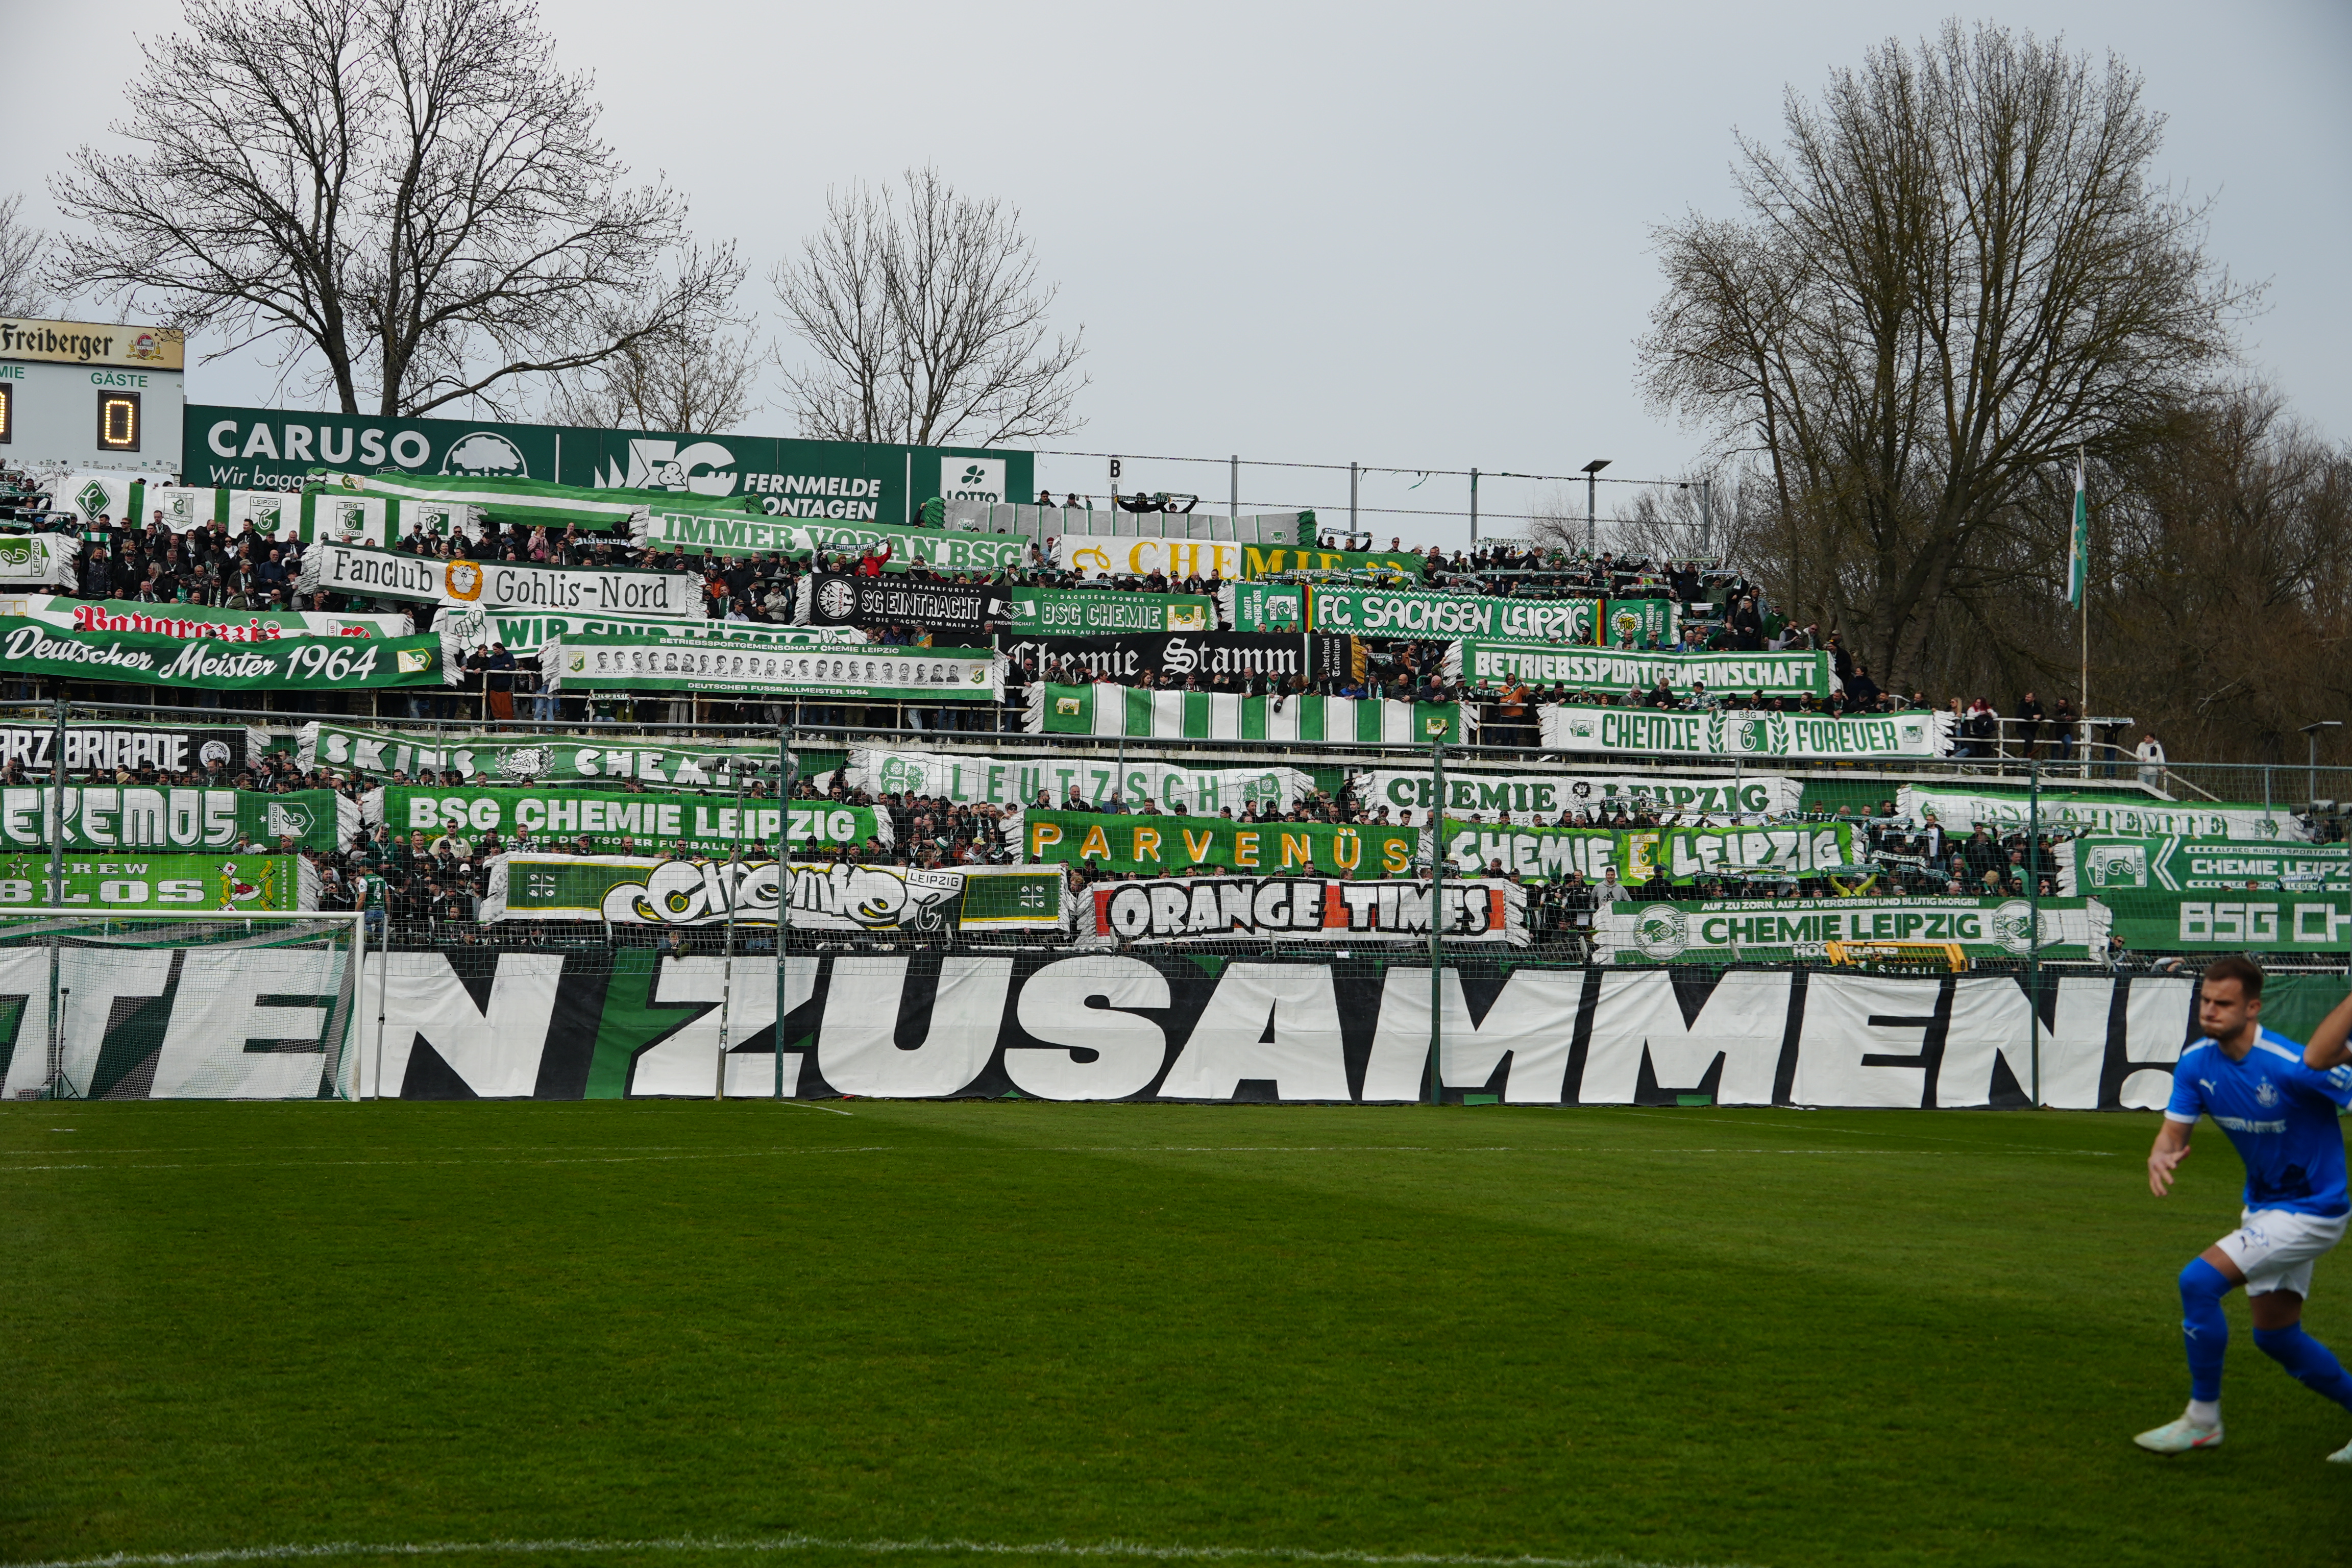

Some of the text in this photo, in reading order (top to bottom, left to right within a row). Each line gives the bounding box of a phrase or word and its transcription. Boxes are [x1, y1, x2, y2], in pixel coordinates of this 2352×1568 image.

[1, 324, 114, 360] Freiberger
[91, 371, 149, 388] GÄSTE
[104, 400, 133, 444] 0
[207, 420, 430, 468] CARUSO
[209, 465, 248, 485] Wir
[1110, 459, 1121, 478] B
[743, 473, 881, 498] FERNMELDE
[763, 496, 878, 519] ONTAGEN
[662, 512, 797, 553] IMMER
[947, 536, 1023, 569] BSG
[857, 542, 876, 550] LEIPZIG
[32, 542, 40, 574] LEIPZIG
[1129, 541, 1343, 583] CHEMIE
[333, 550, 669, 609] Fanclub Gohlis-Nord
[877, 581, 965, 594] SUPER FRANKFURT
[861, 590, 982, 621] SG EINTRACHT
[1060, 594, 1145, 603] SACHSEN-POWER
[1243, 596, 1252, 620] LEIPZIG
[1253, 590, 1263, 627] BSG CHEMIE
[1042, 602, 1162, 630] BSG CHEMIE
[1361, 596, 1491, 635] SACHSEN
[1501, 605, 1589, 638] LEIPZIG
[1646, 603, 1655, 634] SACHSEN
[1655, 610, 1663, 633] LEIPZIG
[5, 625, 379, 681] Deutscher Meister 1964
[659, 638, 818, 651] BETRIEBSSPORTGEMEINSCHAFT
[820, 645, 859, 653] CHEMIE
[1009, 638, 1297, 677] Chemie Stamm
[1332, 639, 1341, 677] Tradition
[1475, 651, 1817, 687] BETRIEBSSPORTGEMEINSCHAFT
[688, 682, 748, 691] DEUTSCHER
[751, 685, 843, 695] FUSSBALLMEISTER
[1602, 713, 1898, 752] CHEMIE FOREVER
[64, 728, 188, 772] BRIGADE
[323, 733, 476, 779] SKINS
[951, 762, 1219, 813] LEUTZSCH
[1386, 777, 1769, 813] CHEMIE LEIPZIG
[409, 797, 855, 842] BSG CHEMIE LEIPZIG
[2045, 807, 2228, 839] CHEMIE
[498, 835, 551, 843] JARE
[558, 836, 652, 846] DETSCER
[1032, 822, 1410, 874] PARVENÜS
[1450, 830, 1839, 878] CHEMIE LEIPZIG
[2216, 847, 2342, 855] ALFRED-KUNZE-SPORTPARK
[43, 862, 150, 875] CREW
[909, 874, 961, 887] LEIPZIG
[2095, 850, 2103, 884] LEIPZIG
[2191, 859, 2278, 875] CHEMIE
[0, 879, 205, 903] BLOS
[374, 883, 382, 900] 4
[1701, 896, 1980, 911] AUF ZU ZORN, AUF ZU VERDERBEN UND BLUTIG MORGEN
[1110, 882, 1488, 937] ORANGE TIMES
[2179, 901, 2278, 943] BSG
[1671, 915, 1685, 943] ULTRAS
[1701, 913, 1982, 944] CHEMIE LEIPZIG
[1995, 915, 2011, 943] ULTRAS
[1793, 943, 1899, 958] HOOIGANS
[630, 955, 2196, 1110] ZUSAMMEN!
